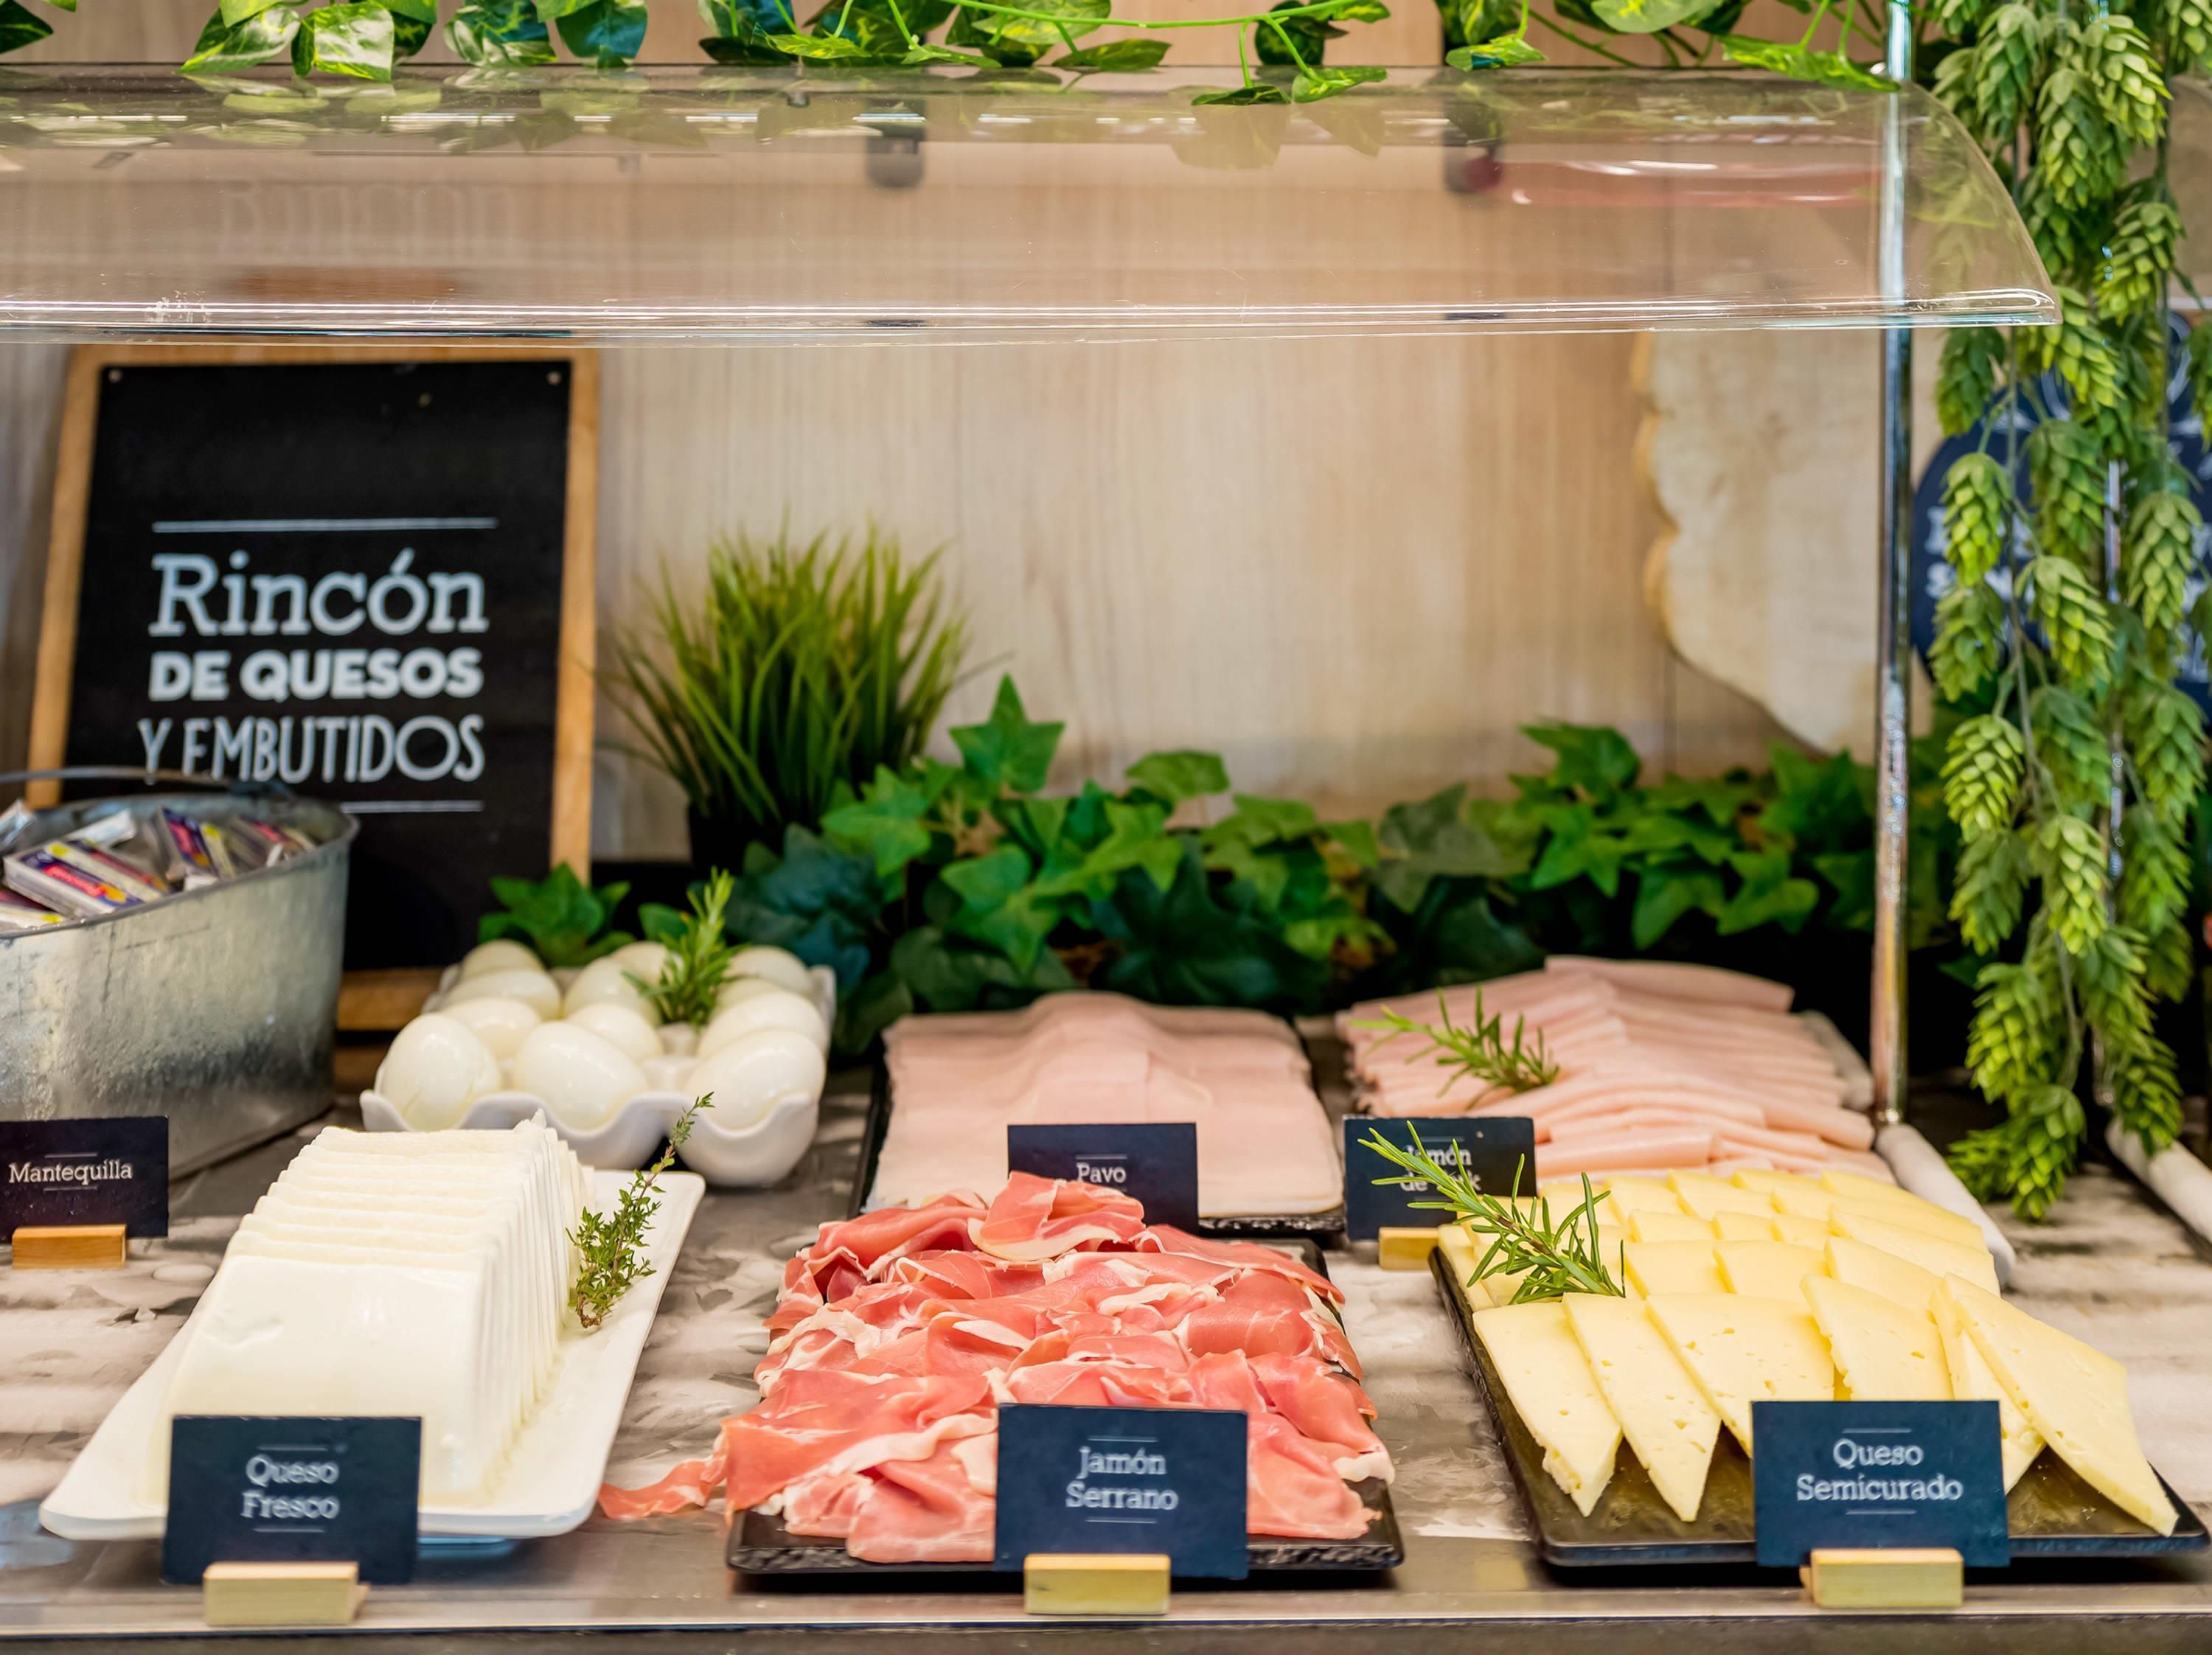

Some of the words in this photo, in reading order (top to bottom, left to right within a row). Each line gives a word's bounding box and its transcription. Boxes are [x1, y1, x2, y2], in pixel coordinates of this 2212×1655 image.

[148, 548, 489, 636] Rincón
[149, 651, 231, 701] DE
[240, 647, 484, 703] QUESOS
[137, 718, 173, 784] Y
[181, 714, 484, 784] EMBUTIDOS
[8, 1159, 133, 1186] Mantequilla
[1075, 1162, 1127, 1183] Pavo
[1076, 1446, 1166, 1480] Jamón
[1832, 1438, 1924, 1469] Queso
[246, 1454, 339, 1488] Queso
[1065, 1480, 1179, 1511] Serrano
[1797, 1473, 1964, 1501] Semicurado
[240, 1489, 340, 1519] Fresco
